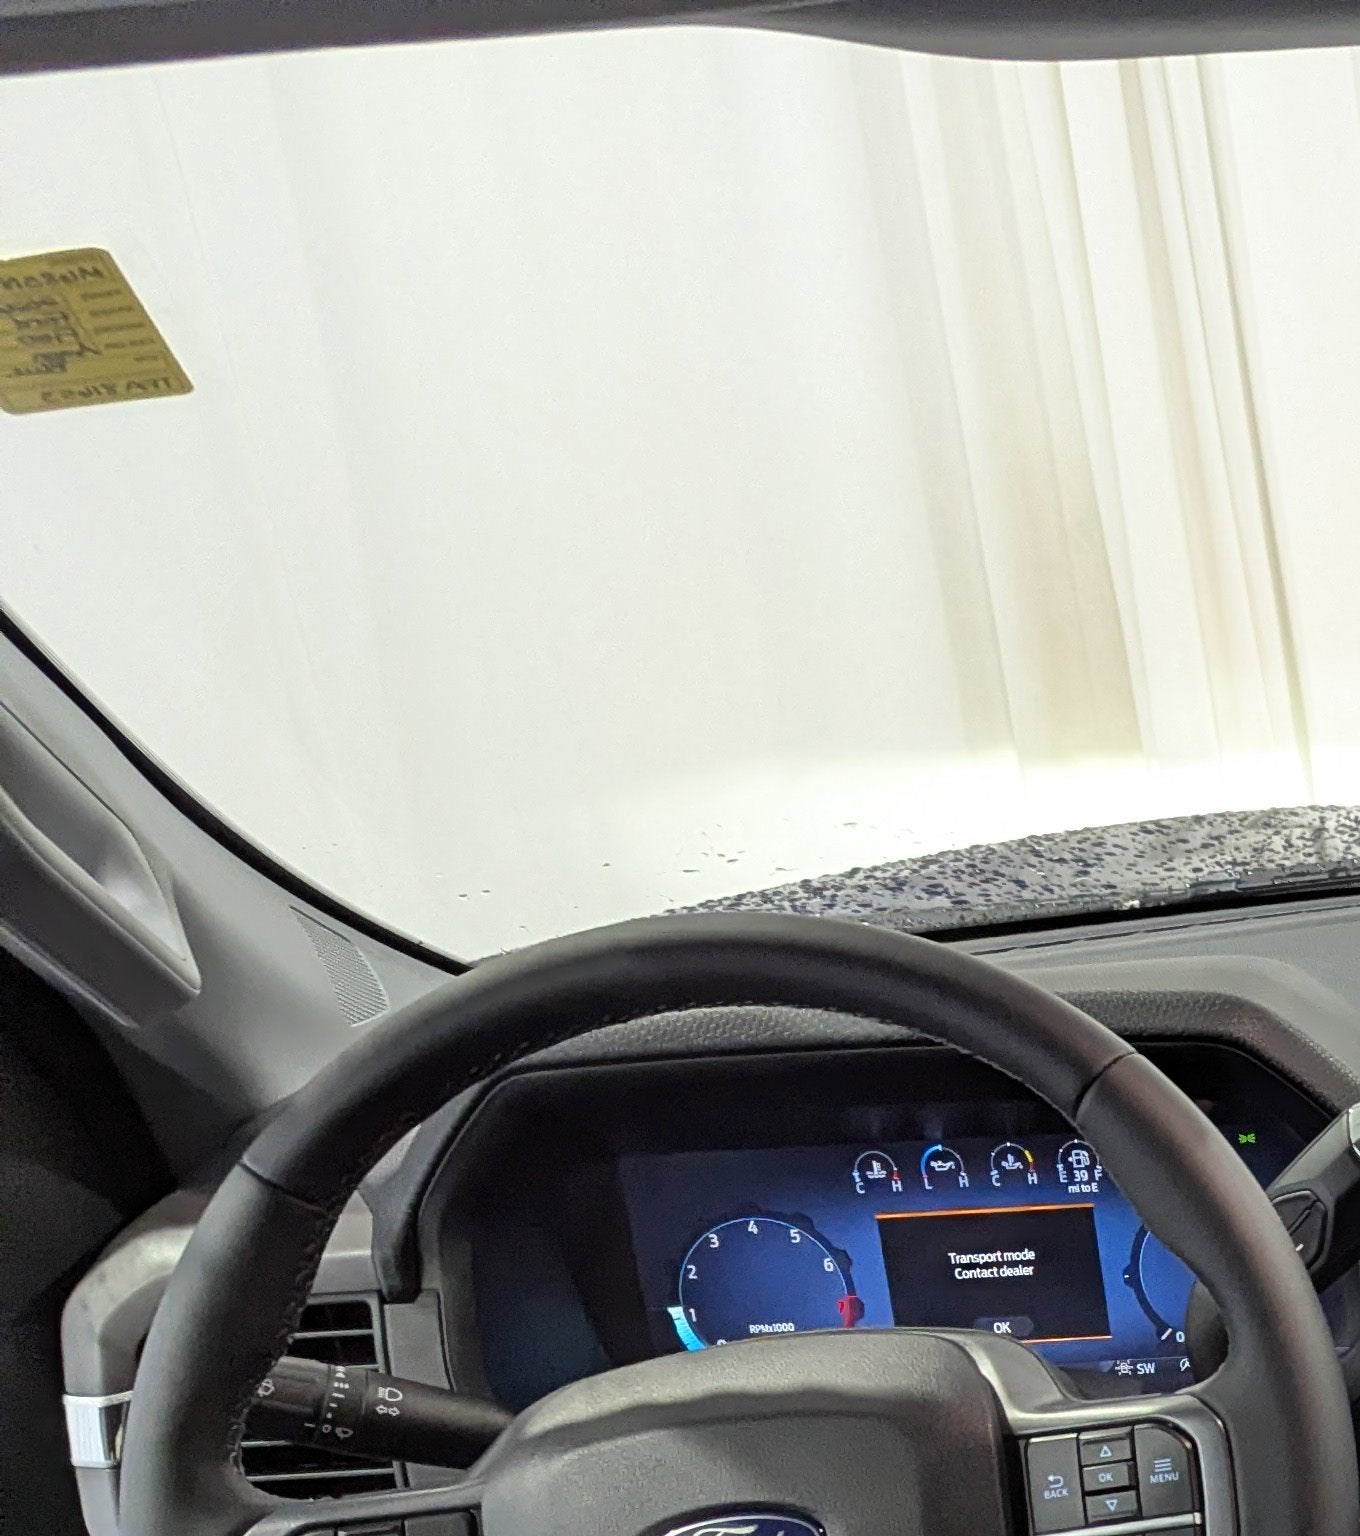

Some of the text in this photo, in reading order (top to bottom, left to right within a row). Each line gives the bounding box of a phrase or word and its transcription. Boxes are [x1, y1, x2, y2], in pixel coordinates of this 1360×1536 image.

[958, 1176, 969, 1188] H
[1027, 1172, 1038, 1185] H
[1073, 1170, 1089, 1183] 39
[891, 1180, 903, 1193] H
[1068, 1183, 1099, 1193] mi to E
[747, 1220, 758, 1235] 4
[708, 1233, 720, 1248] 3
[789, 1229, 801, 1243] 5
[948, 1248, 1036, 1266] Transport mode
[823, 1257, 835, 1272] 6
[687, 1265, 698, 1279] 2
[954, 1264, 1034, 1280] Contact dealer
[688, 1308, 697, 1322] 1
[993, 1321, 1012, 1334] OK
[1176, 1331, 1186, 1343] 0
[1136, 1362, 1155, 1374] SW
[1098, 1474, 1114, 1483] OK
[1150, 1472, 1179, 1484] MENU
[1044, 1491, 1069, 1500] BACK
